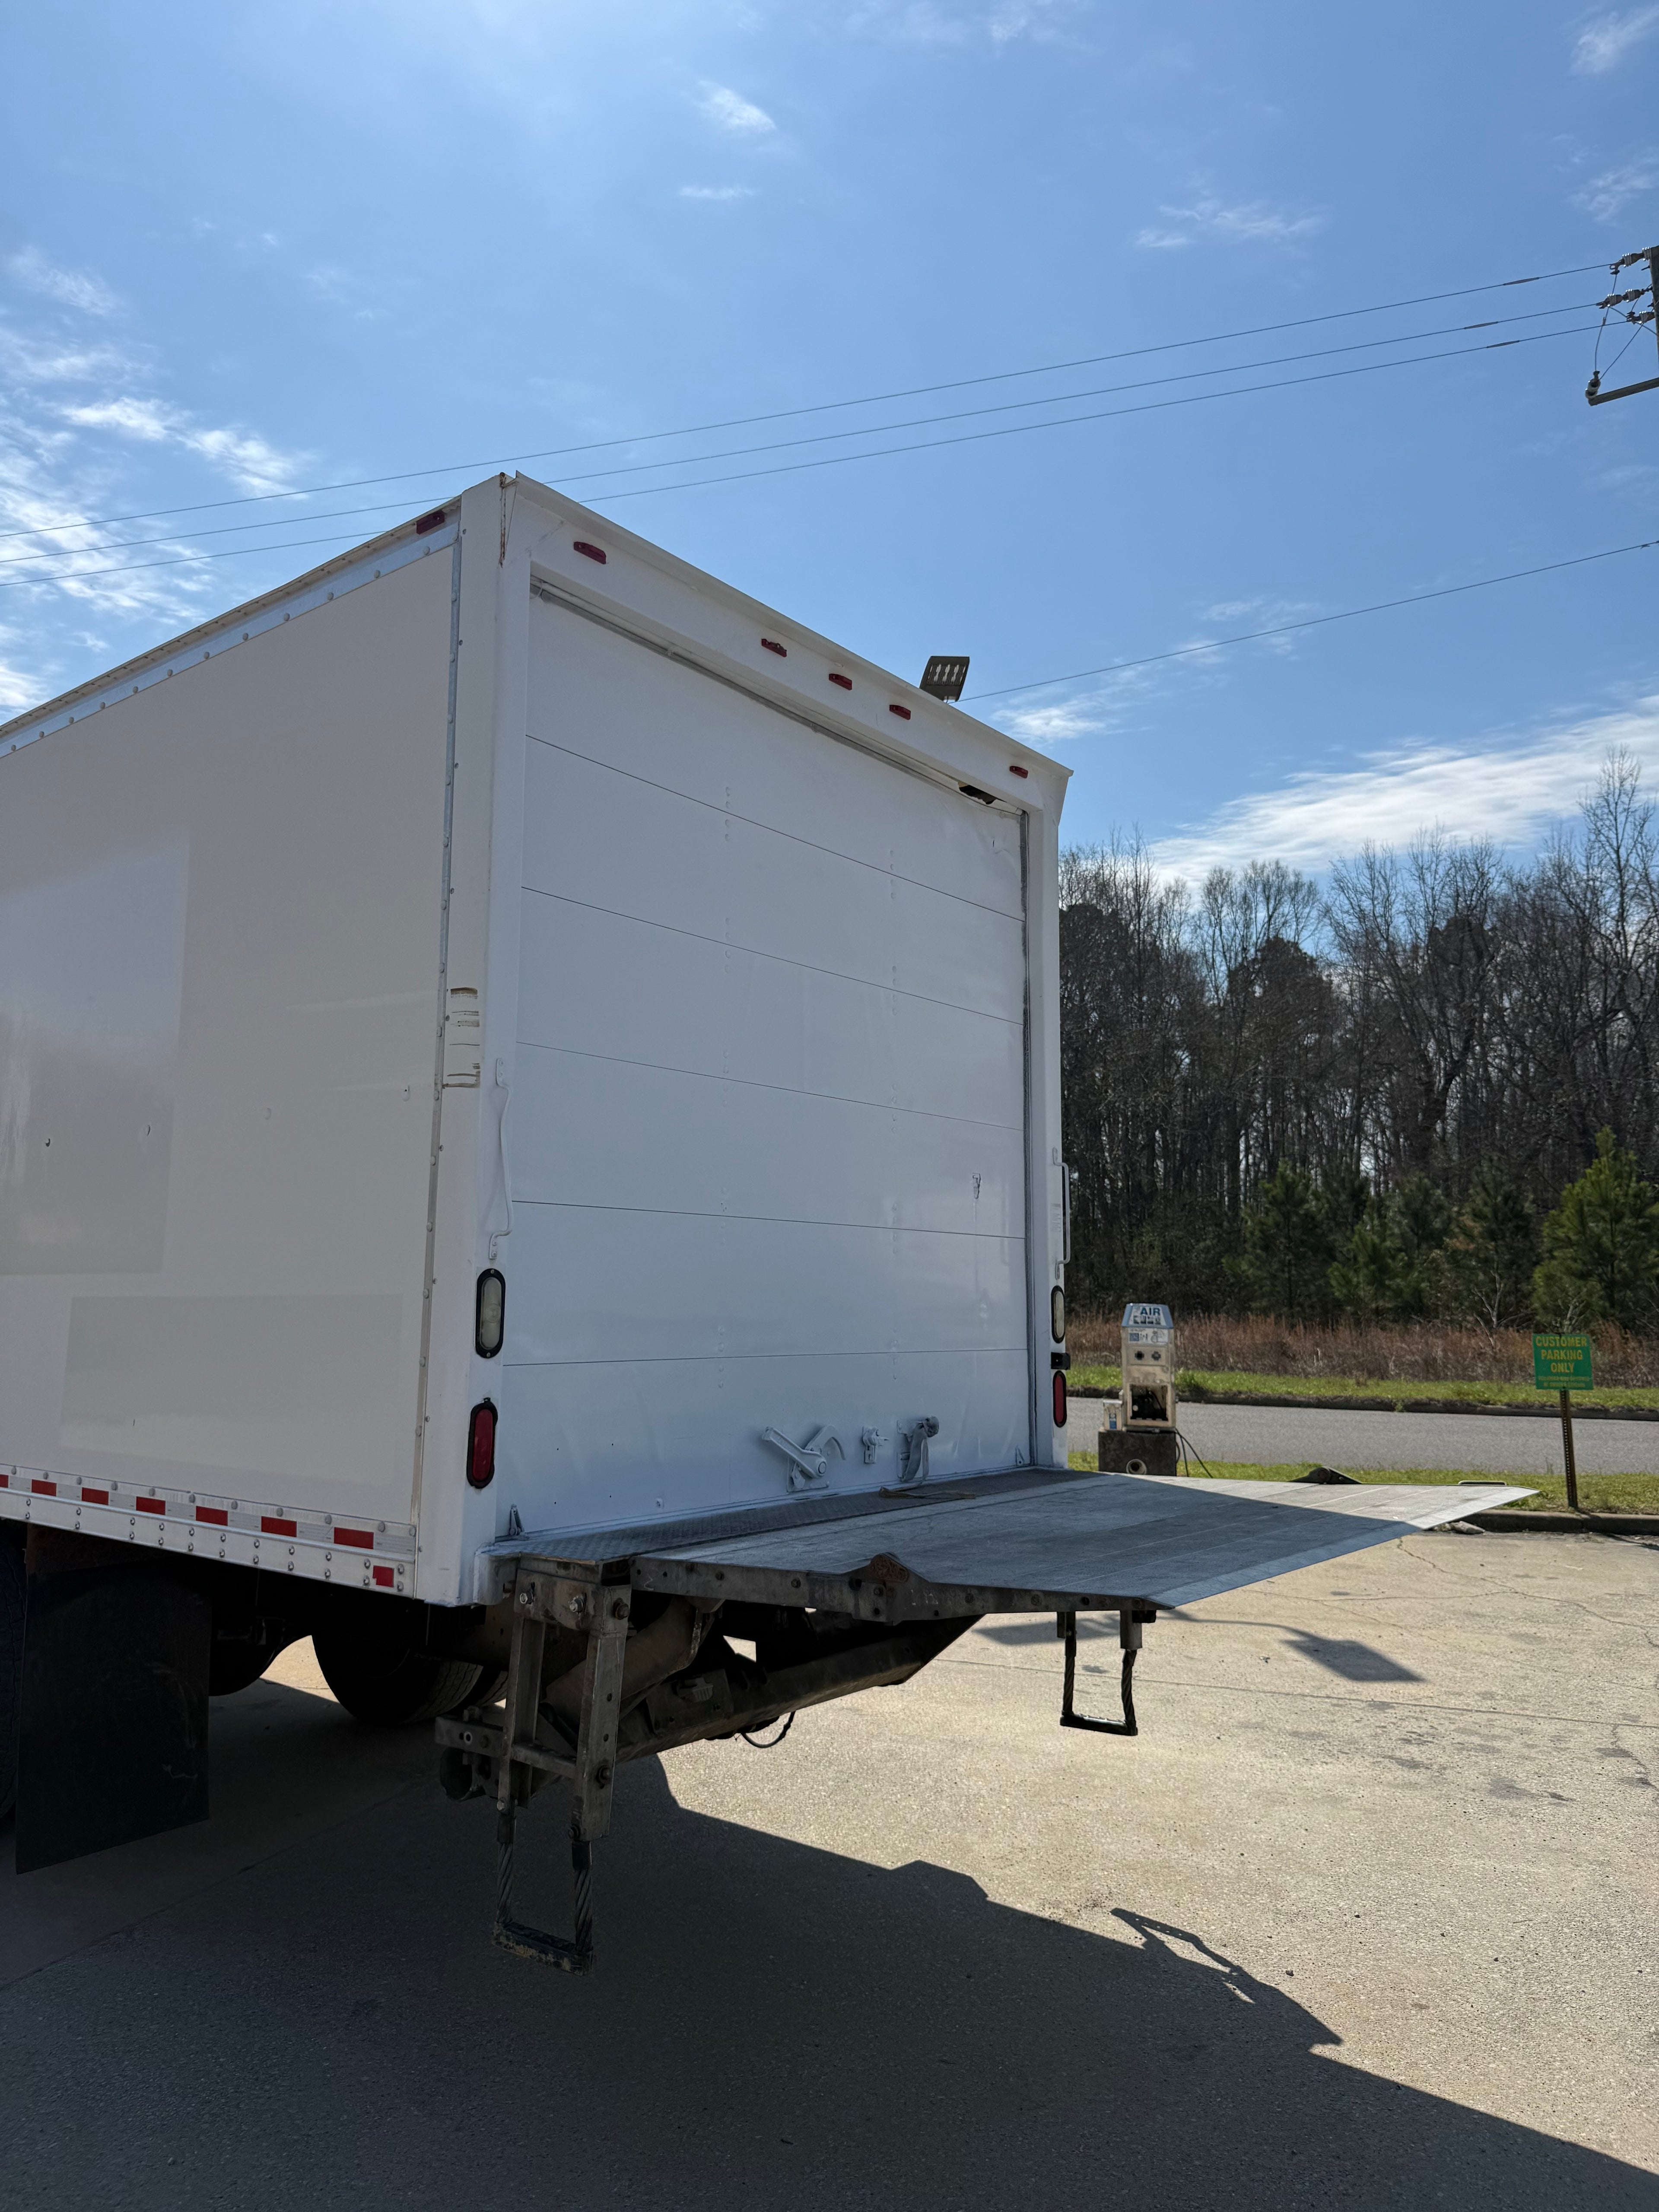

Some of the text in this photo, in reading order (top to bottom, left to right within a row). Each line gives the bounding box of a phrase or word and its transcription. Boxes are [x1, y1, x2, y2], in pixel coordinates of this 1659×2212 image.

[1140, 1307, 1160, 1316] AIR
[1535, 1336, 1587, 1347] CUSTOMER
[1541, 1350, 1583, 1360] PARKING
[1551, 1363, 1574, 1373] ONLY
